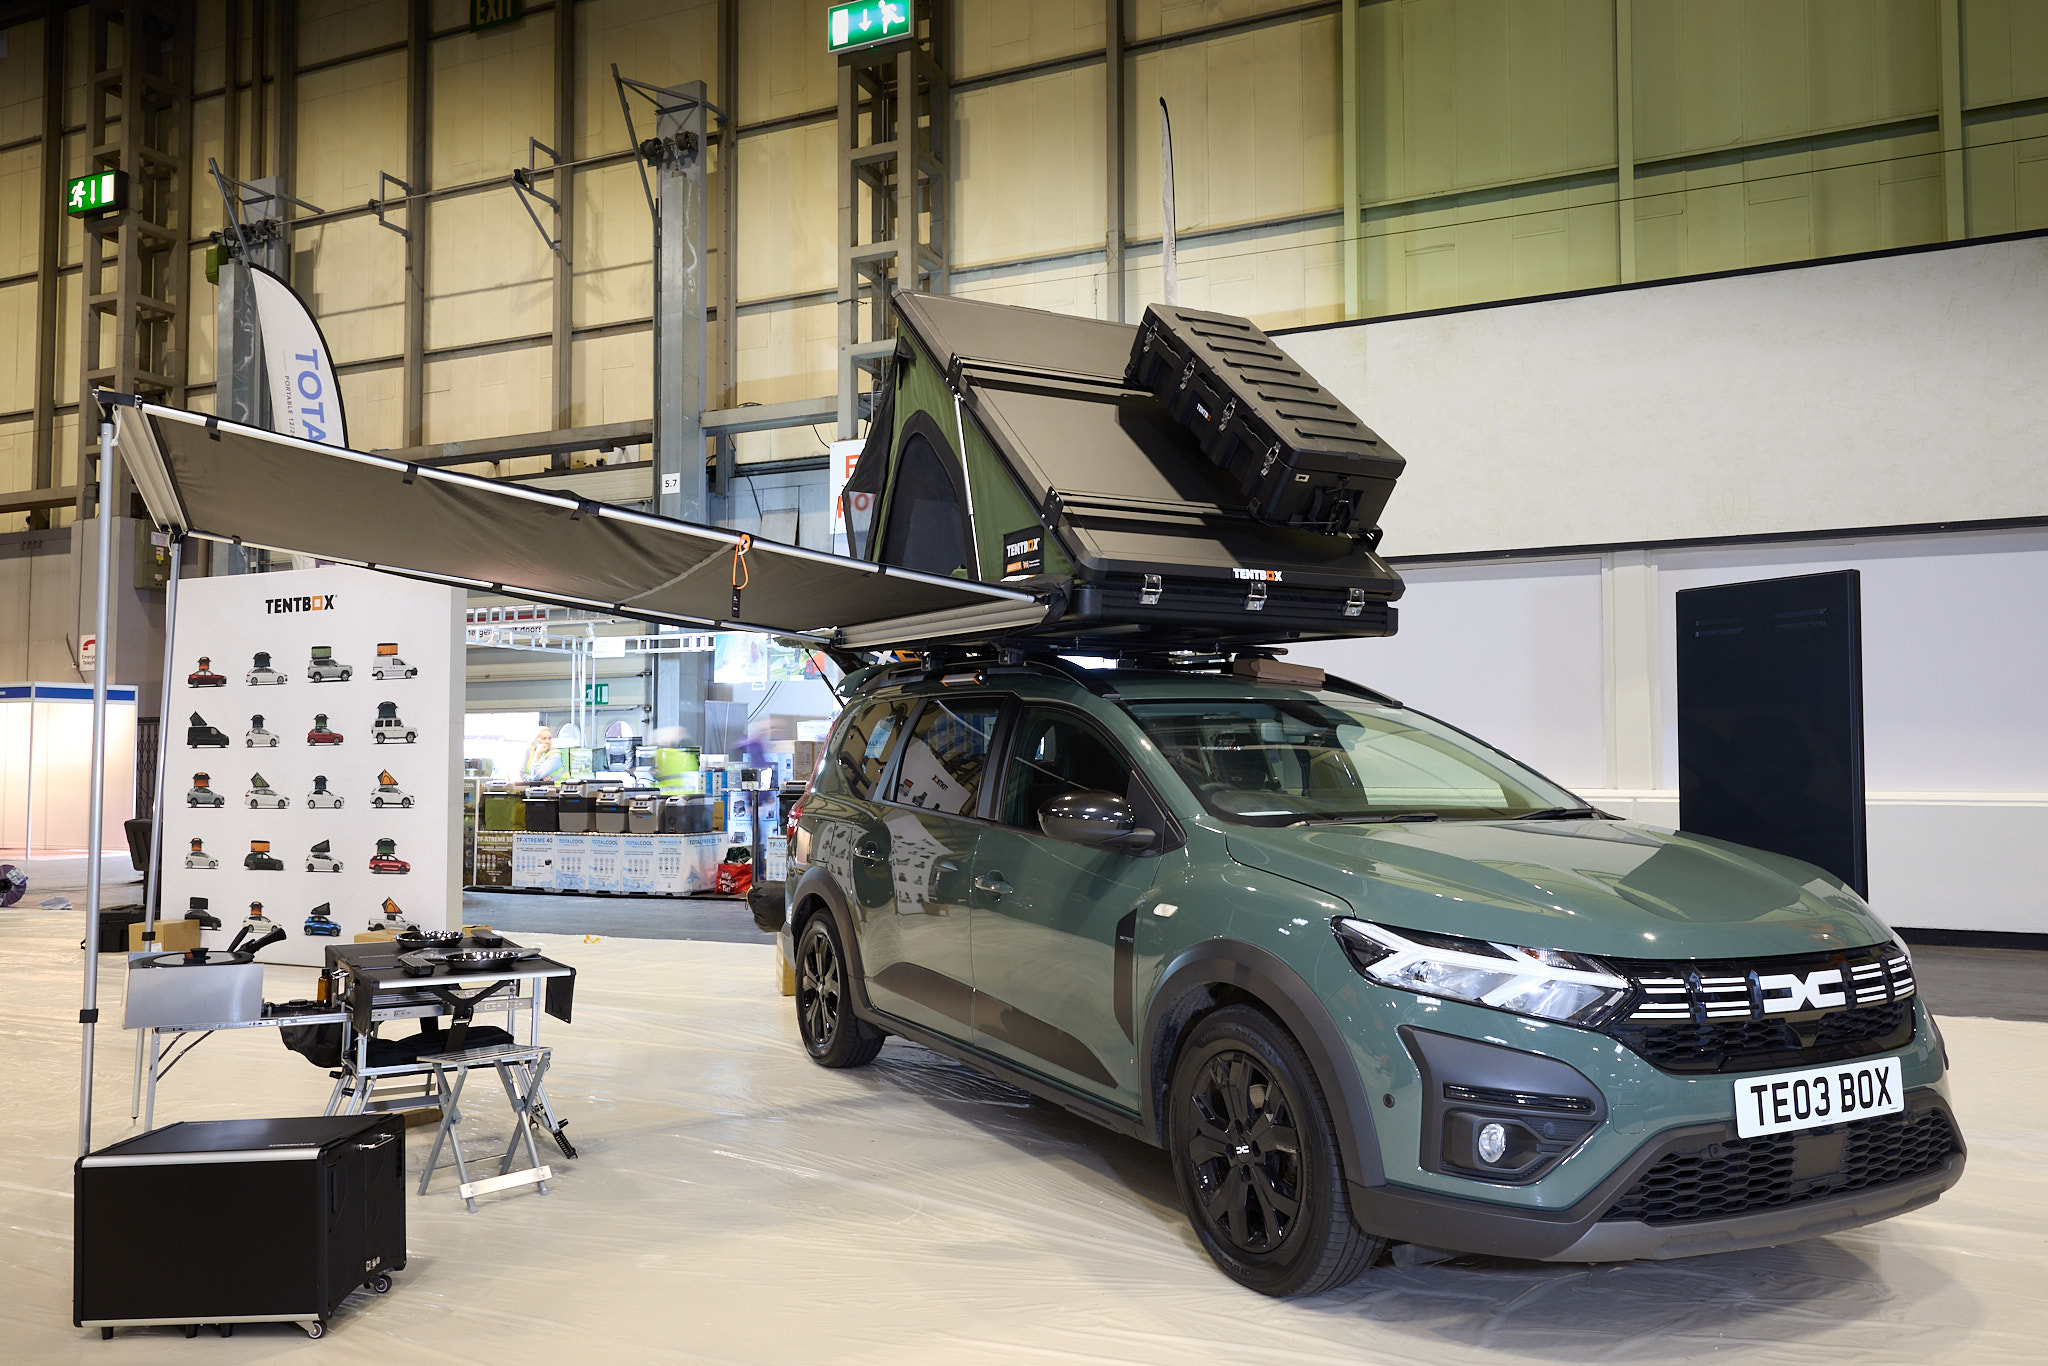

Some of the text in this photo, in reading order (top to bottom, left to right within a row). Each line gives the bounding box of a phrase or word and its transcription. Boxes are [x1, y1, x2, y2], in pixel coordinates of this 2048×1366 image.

[284, 375, 296, 437] PORTABLE 12/2
[664, 479, 677, 488] 5.7
[1005, 537, 1040, 557] TENTBOX
[1232, 567, 1283, 582] TENTBOX
[265, 594, 335, 615] TENTBOX
[1750, 1066, 1893, 1127] TE03 BOX
